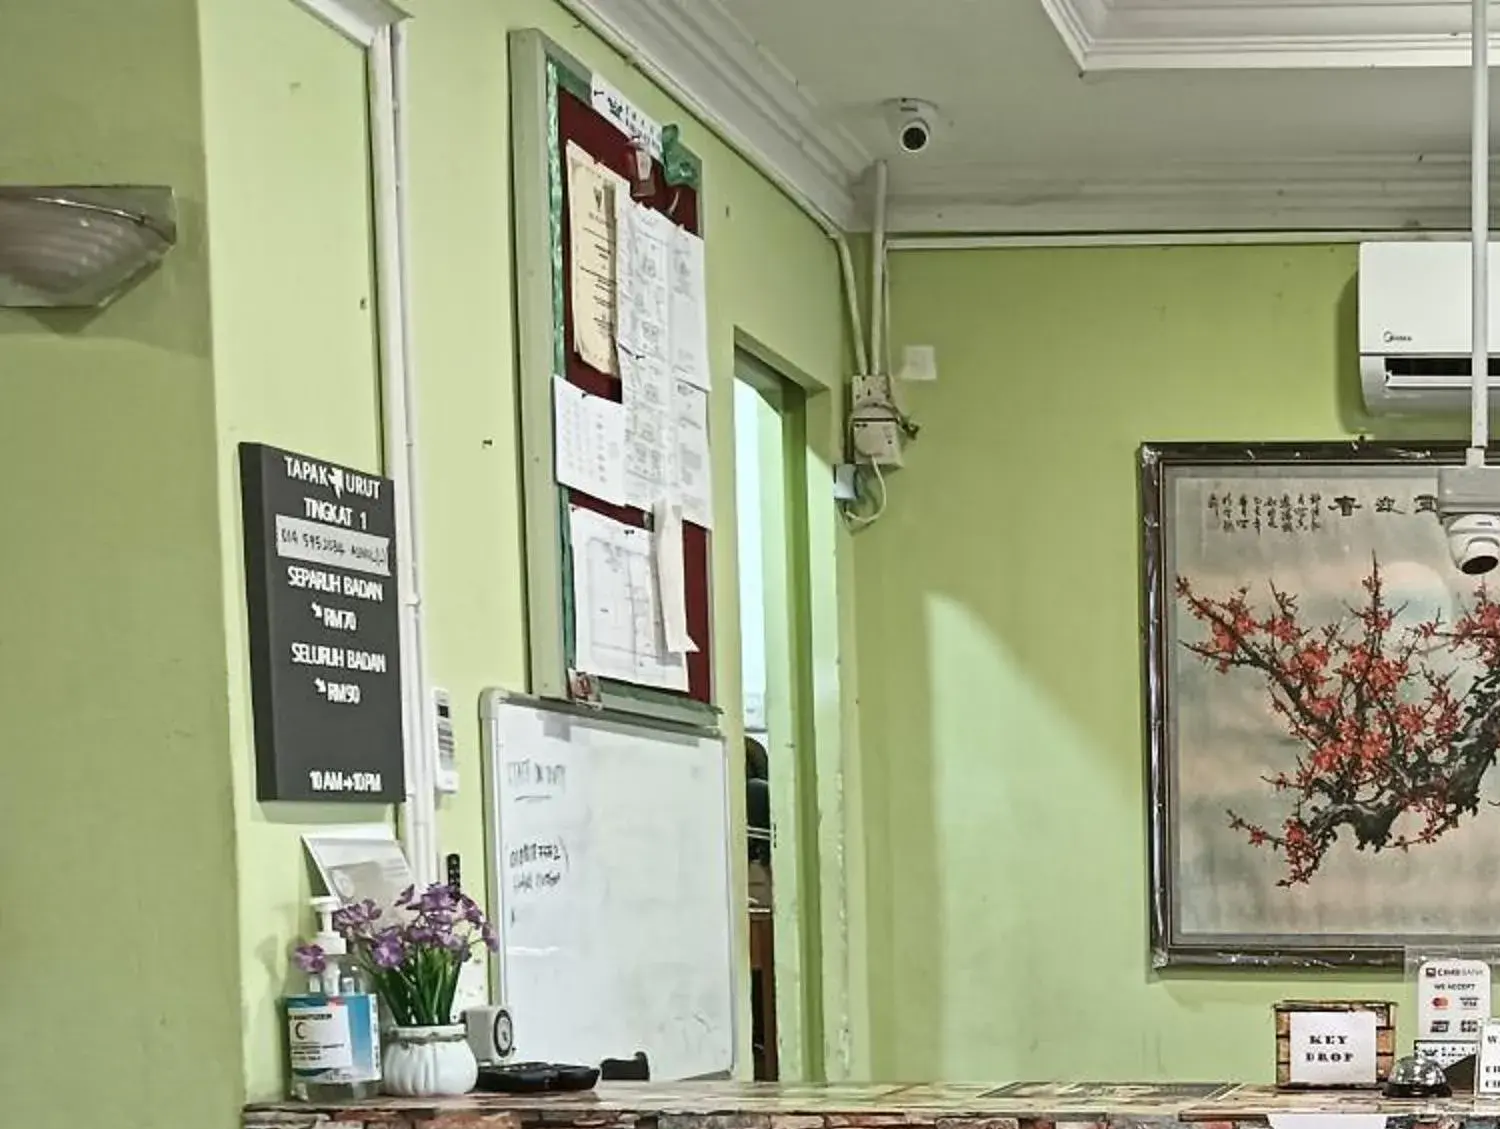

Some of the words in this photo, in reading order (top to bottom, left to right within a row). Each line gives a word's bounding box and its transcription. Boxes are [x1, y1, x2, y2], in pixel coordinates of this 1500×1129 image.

[284, 455, 329, 488] TAPAK
[345, 474, 381, 500] URUT
[303, 497, 353, 528] TINGKAT
[360, 511, 367, 530] 1
[287, 565, 341, 594] SEPARUH
[343, 576, 384, 602] BADAN
[323, 607, 358, 631] RM70
[291, 642, 345, 668] SELURUH
[347, 649, 387, 673] BADAN
[1309, 1034, 1348, 1045] KEY
[1305, 1052, 1354, 1063] DROP
